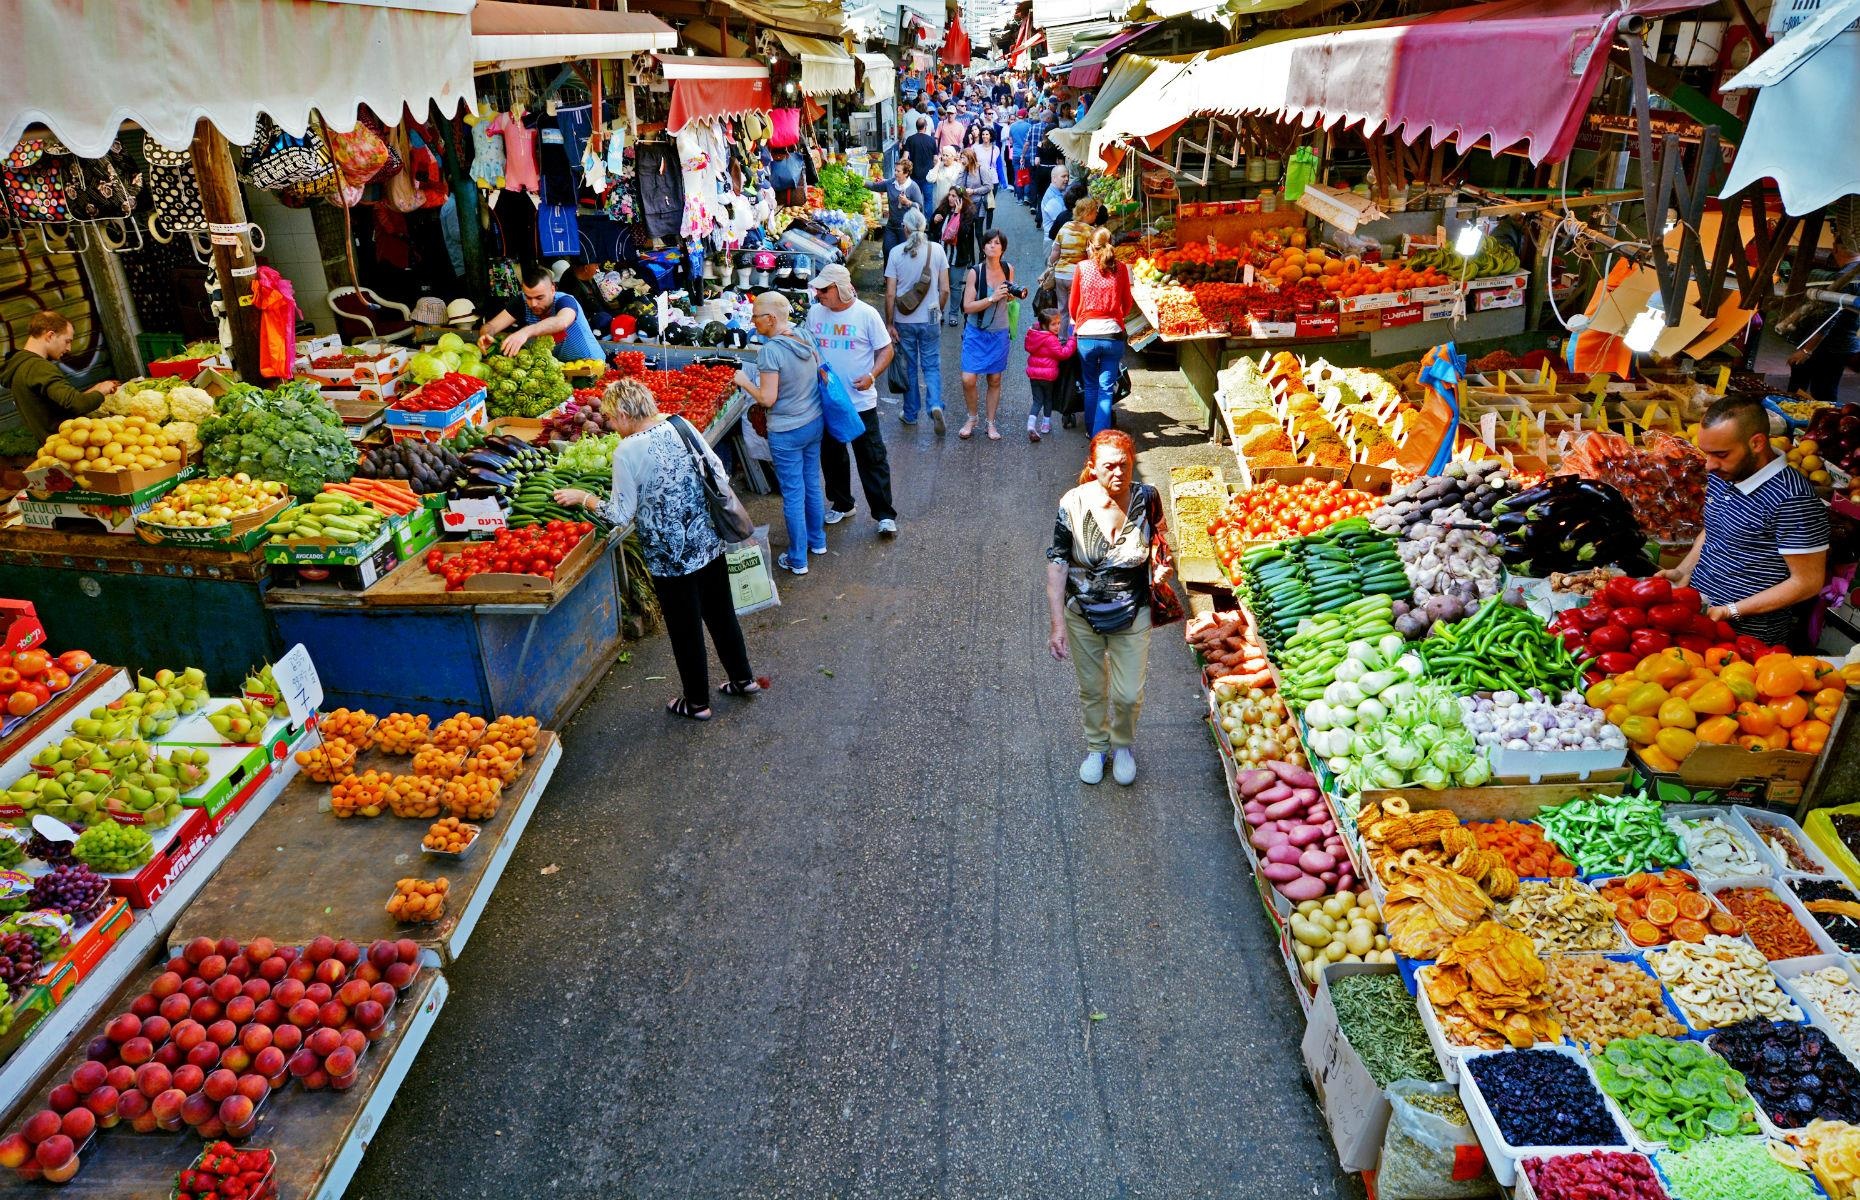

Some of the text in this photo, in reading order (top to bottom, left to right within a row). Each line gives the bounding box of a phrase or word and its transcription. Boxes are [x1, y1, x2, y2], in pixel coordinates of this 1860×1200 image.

[758, 254, 769, 264] NY
[20, 502, 63, 515] מובחרים
[23, 514, 49, 526] פירות
[477, 518, 504, 526] ברעם
[293, 688, 310, 711] 7
